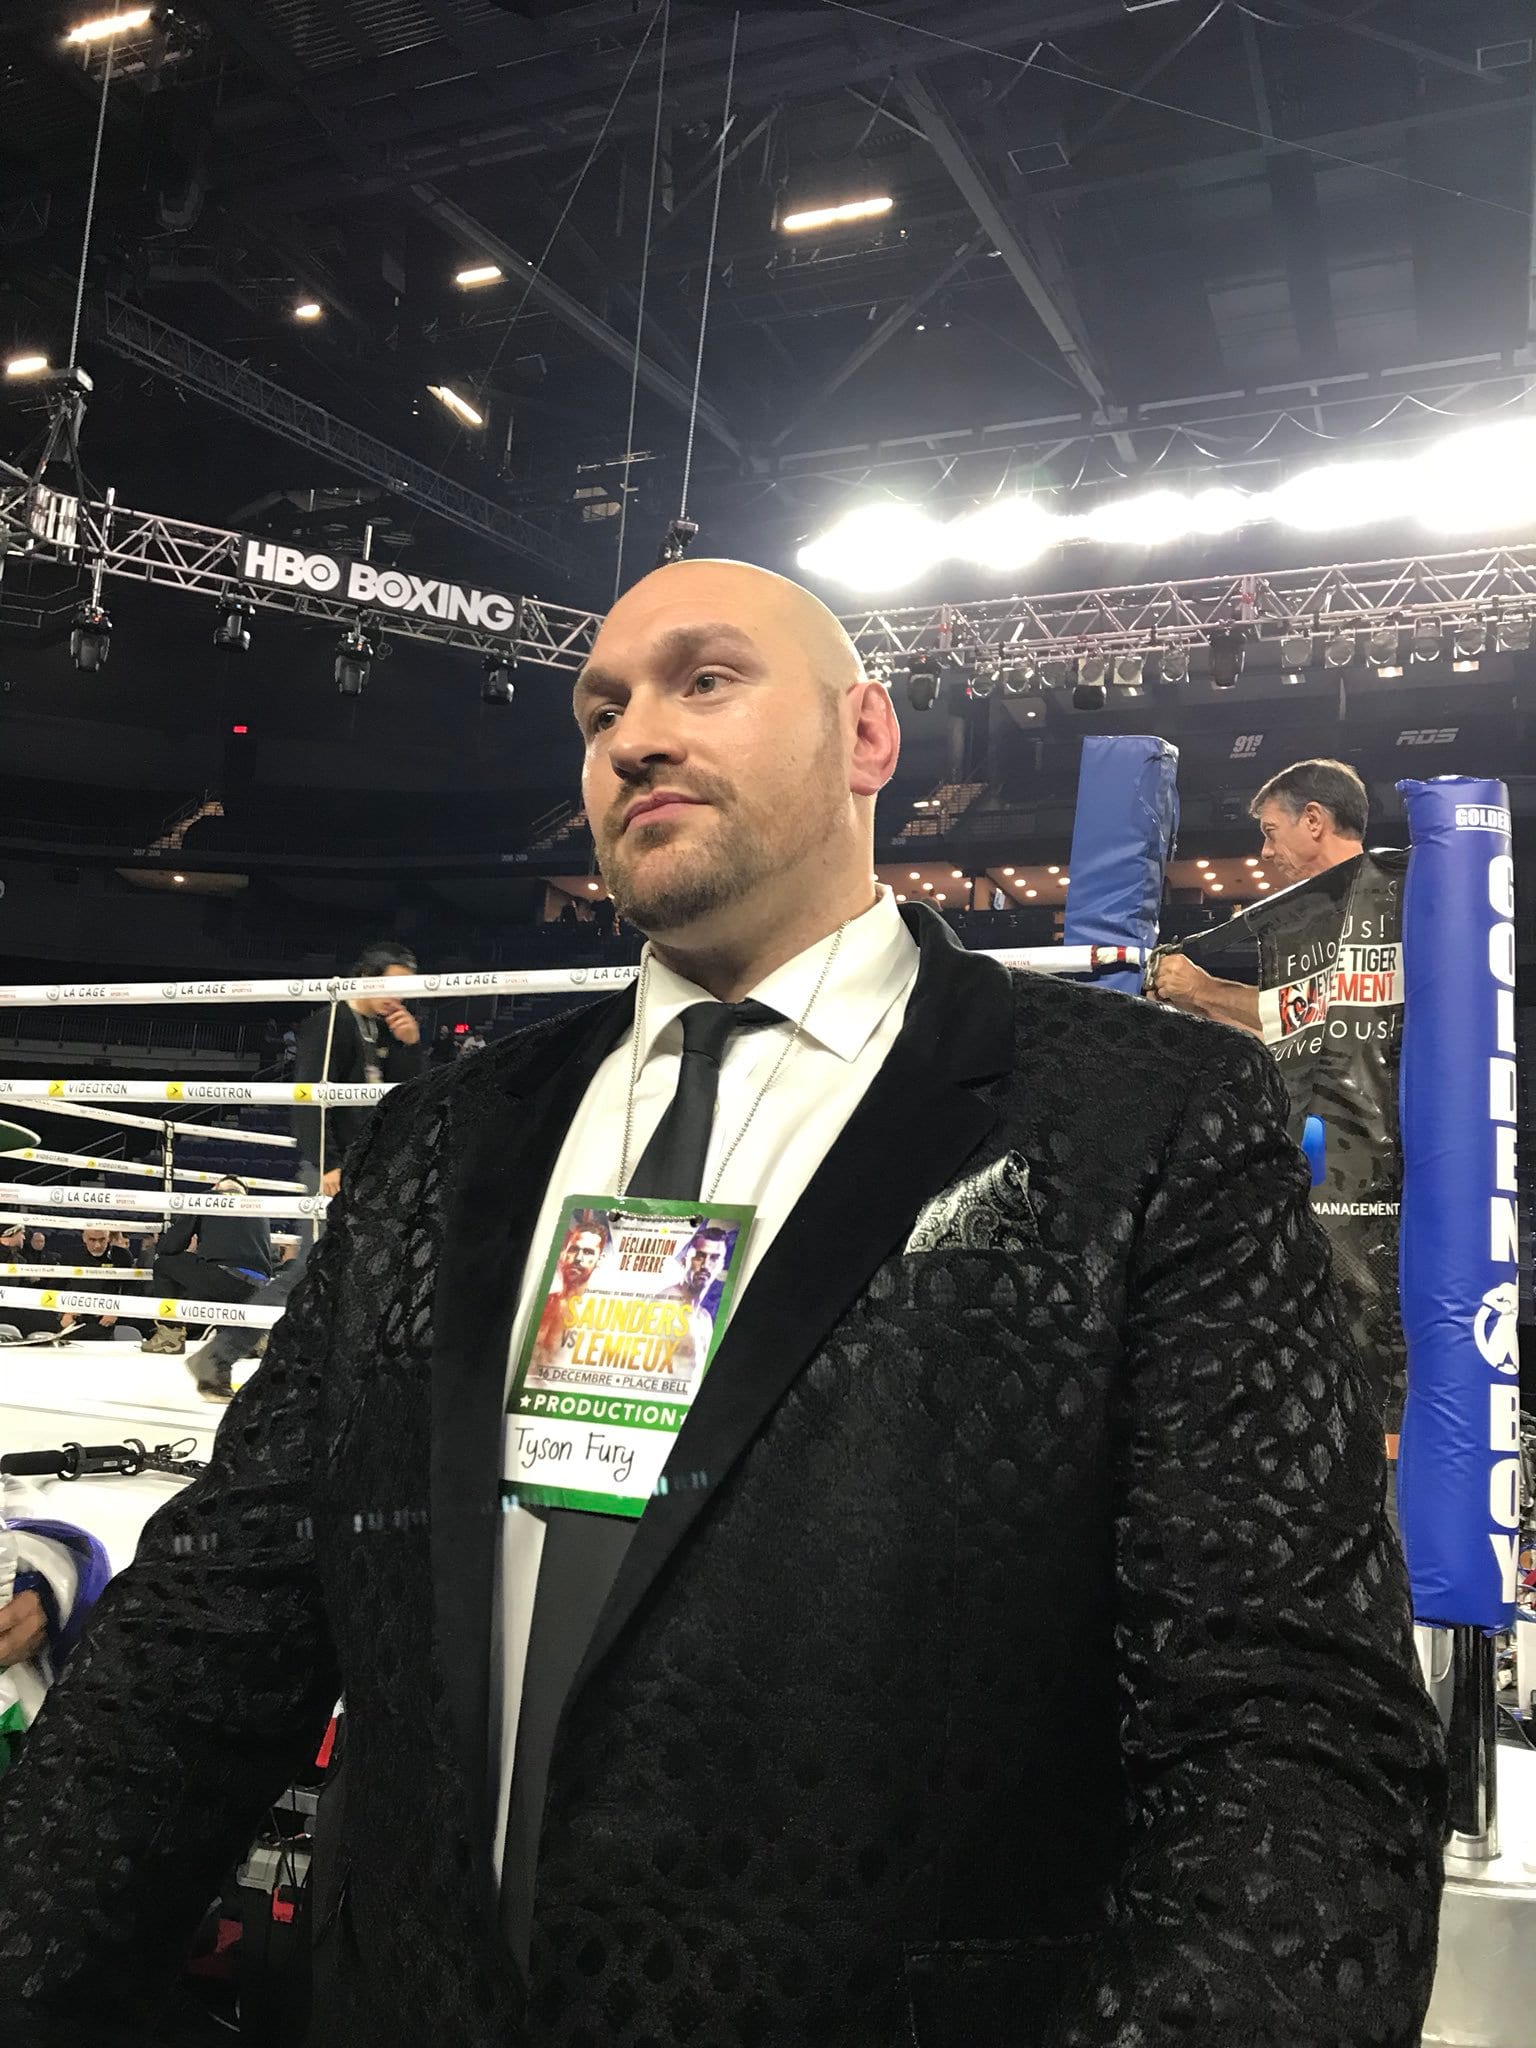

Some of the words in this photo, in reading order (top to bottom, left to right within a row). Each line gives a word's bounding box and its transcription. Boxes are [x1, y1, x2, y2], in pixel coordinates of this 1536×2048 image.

[244, 540, 341, 592] HBO
[347, 562, 515, 631] BOXING
[1287, 942, 1338, 976] Follo
[1350, 947, 1396, 972] TIGER
[446, 976, 460, 986] LA
[465, 974, 498, 985] CAGE
[594, 968, 609, 979] LA
[614, 967, 640, 979] CAG
[63, 988, 76, 997] LA
[79, 987, 106, 997] CAGE
[181, 985, 194, 995] LA
[197, 984, 226, 995] CAGE
[309, 982, 322, 992] LA
[1330, 1013, 1396, 1040] ous!
[67, 1192, 80, 1202] LA
[83, 1192, 111, 1204] CAGE
[188, 1197, 201, 1207] LA
[205, 1197, 236, 1209] CAGE
[1311, 1201, 1401, 1216] MANAGEMENT
[619, 1254, 632, 1271] DE
[633, 1256, 666, 1274] GUERRE
[563, 1295, 693, 1338] SAUNDERS
[571, 1331, 680, 1375] LEMIEUX
[552, 1368, 613, 1385] DÉCEMBRE
[622, 1376, 659, 1391] PLACE
[660, 1380, 689, 1393] BELL
[533, 1394, 677, 1426] PRODUCTION
[514, 1427, 572, 1469] Tyson
[586, 1432, 635, 1482] Fury
